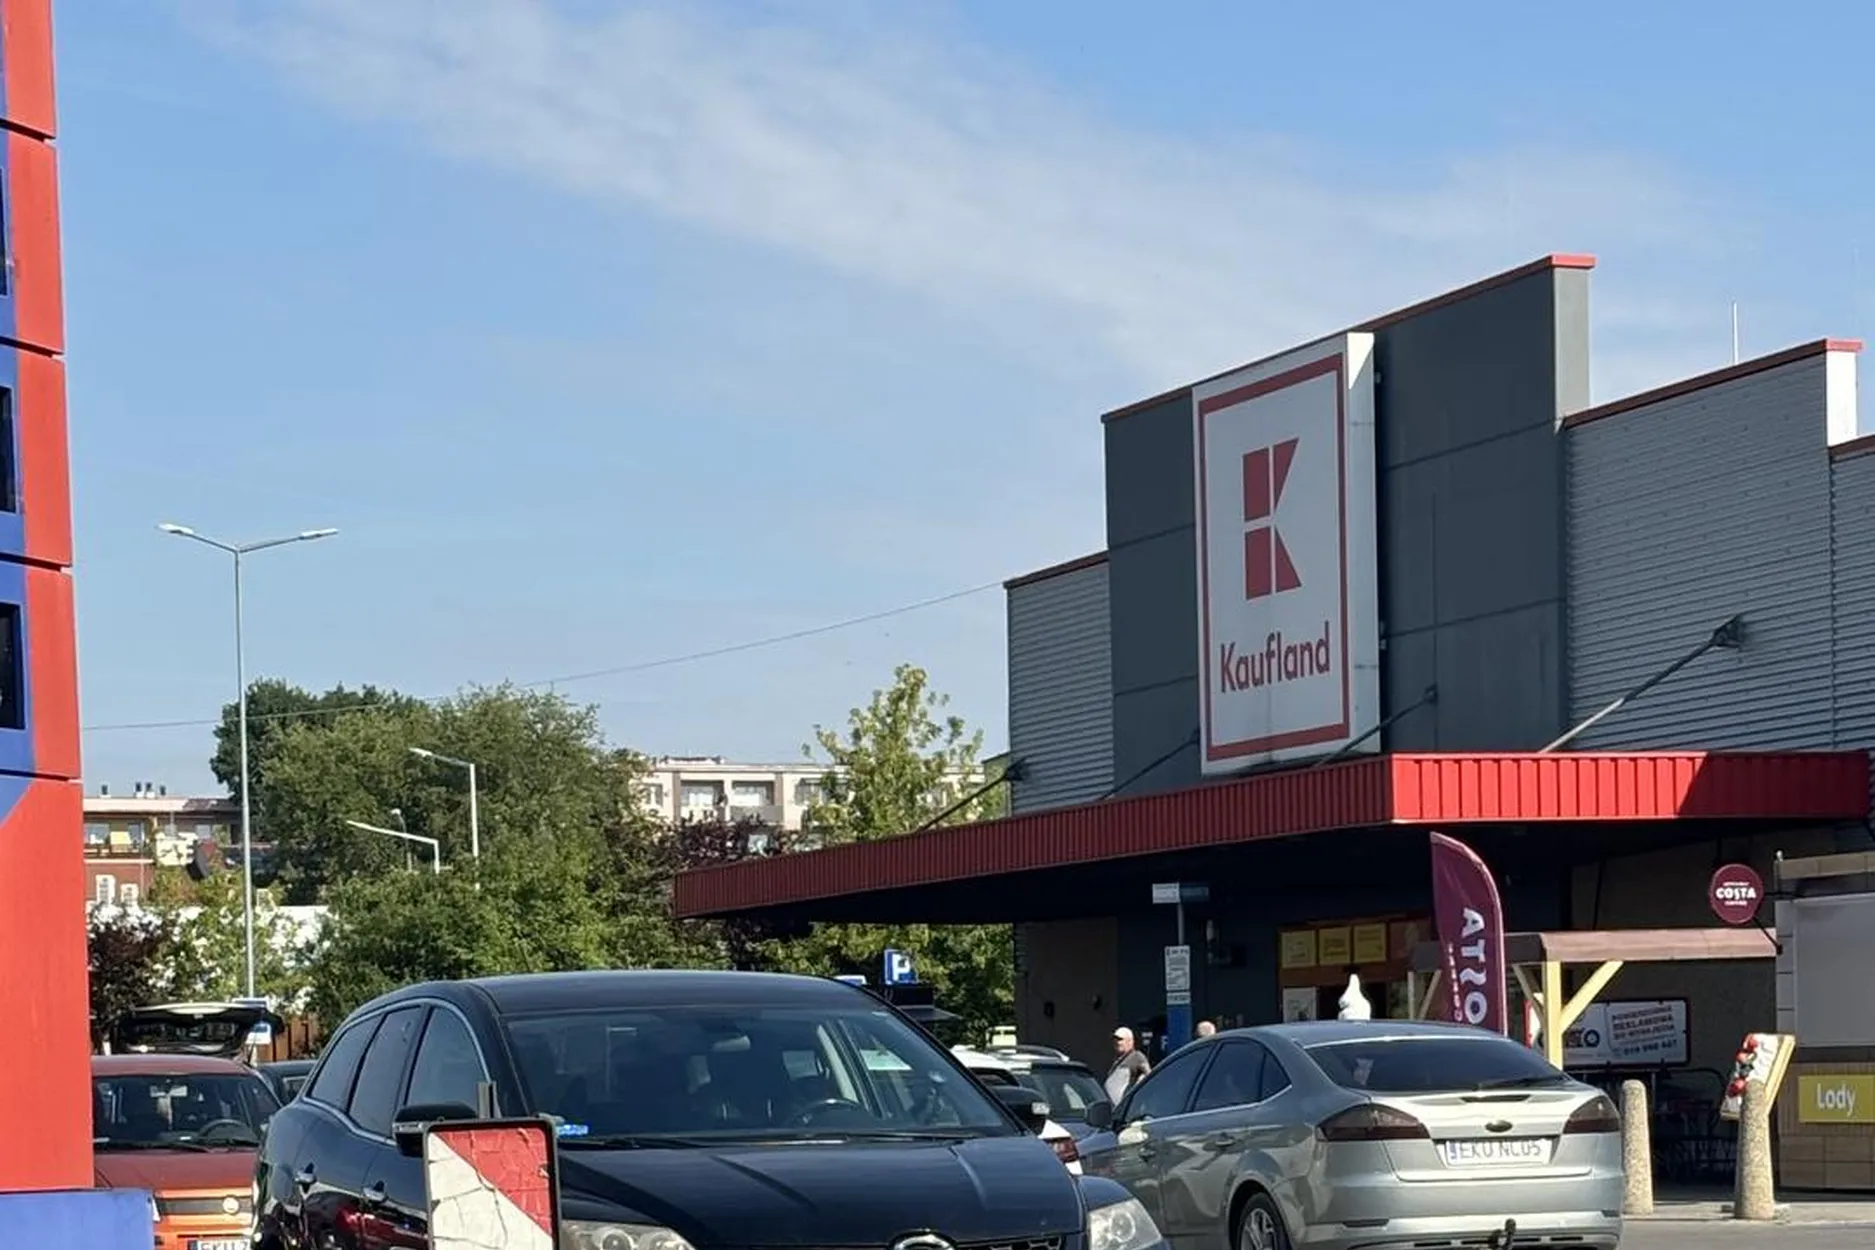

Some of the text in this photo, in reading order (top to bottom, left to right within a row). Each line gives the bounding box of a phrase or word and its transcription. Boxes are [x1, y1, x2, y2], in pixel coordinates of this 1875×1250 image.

[1220, 620, 1330, 693] Kaufland
[1715, 887, 1757, 900] COSTA
[892, 954, 910, 981] P
[1817, 1083, 1856, 1117] Lody
